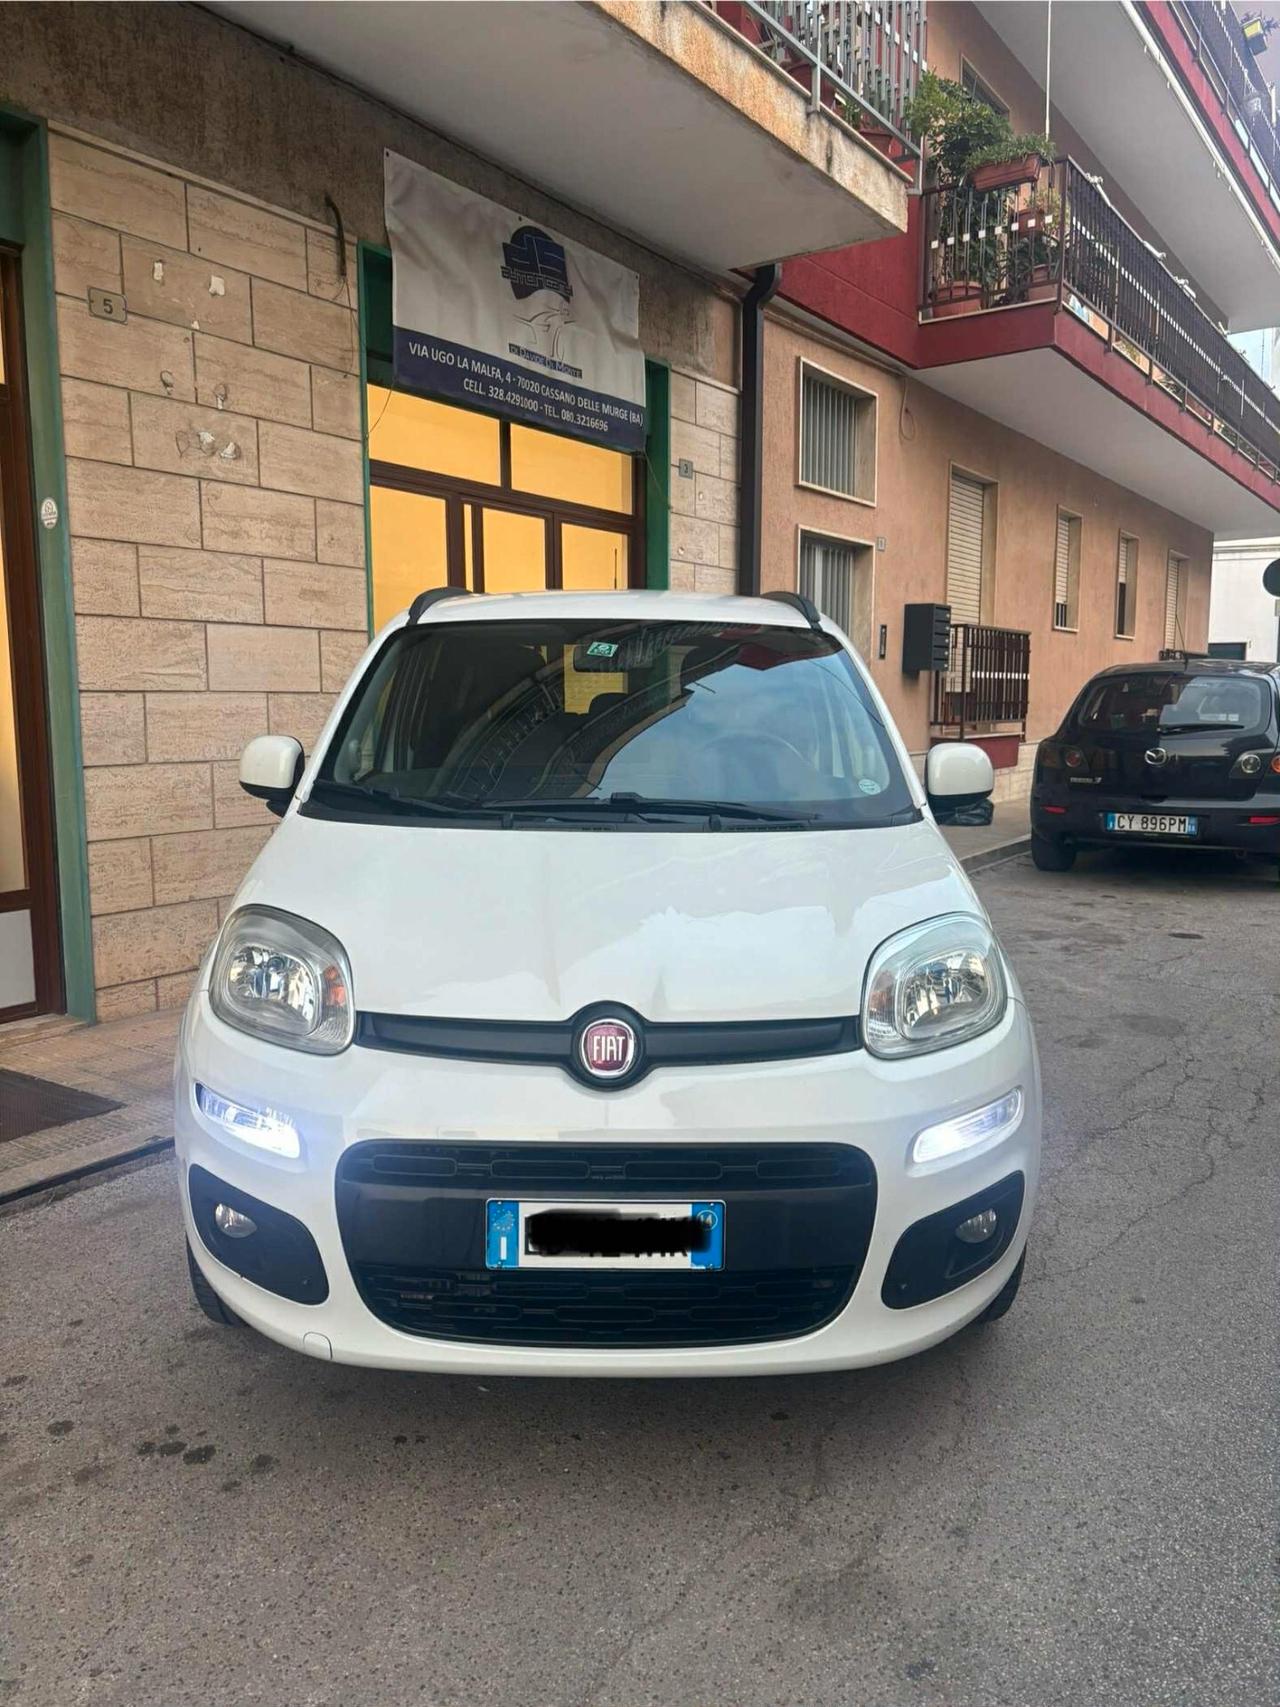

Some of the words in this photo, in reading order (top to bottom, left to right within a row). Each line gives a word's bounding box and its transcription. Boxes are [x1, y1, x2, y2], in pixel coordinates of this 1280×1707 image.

[103, 298, 113, 314] 5
[408, 342, 429, 358] VIA
[431, 347, 455, 365] UGO
[457, 355, 469, 370] LA
[471, 359, 504, 384] MALFA,
[505, 371, 511, 385] 4
[517, 375, 540, 394] 70020
[541, 384, 576, 406] CASSANO
[577, 396, 600, 413] DELLE
[602, 403, 629, 421] MURGE
[629, 409, 643, 427] (BA)
[463, 378, 486, 396] CELL.
[544, 403, 560, 419] TEL.
[1118, 815, 1135, 830] CY
[1141, 816, 1187, 832] 896PM
[593, 1035, 626, 1062] FIAT
